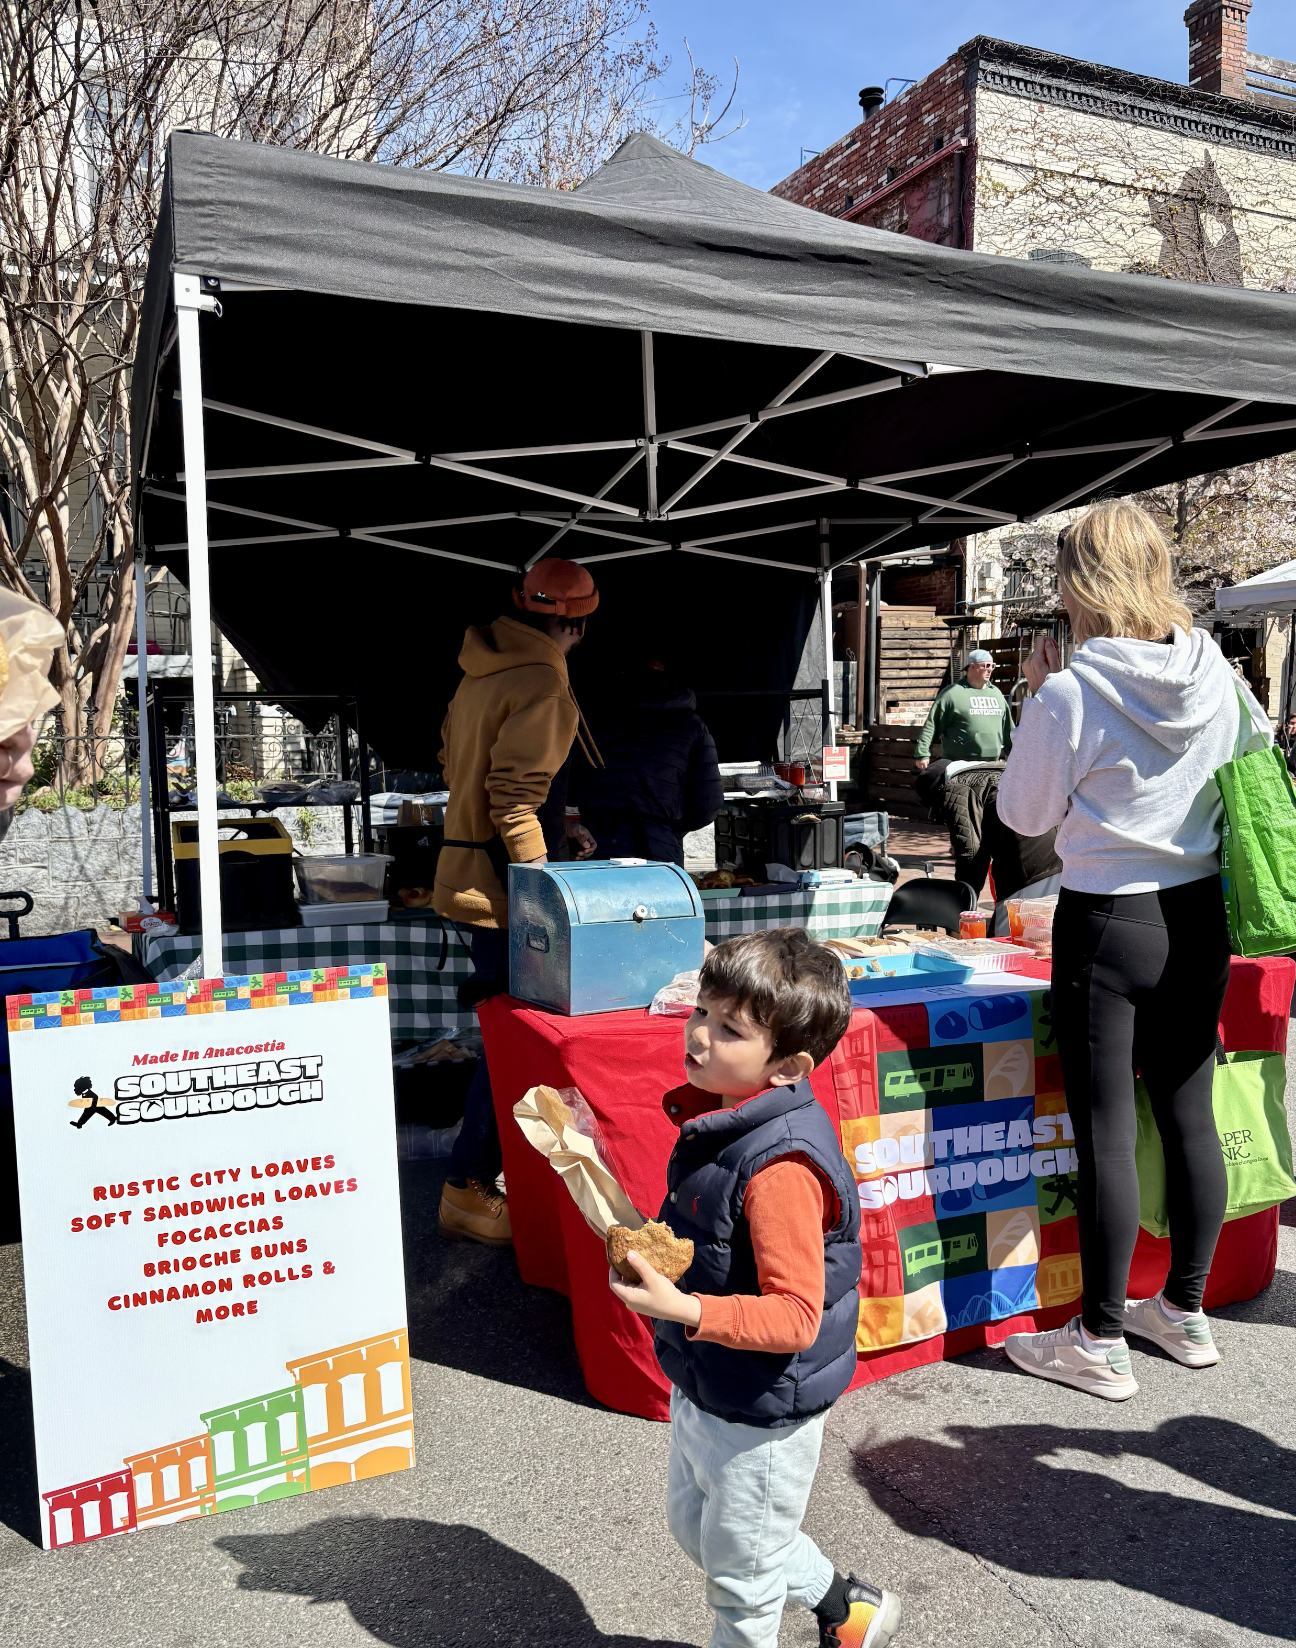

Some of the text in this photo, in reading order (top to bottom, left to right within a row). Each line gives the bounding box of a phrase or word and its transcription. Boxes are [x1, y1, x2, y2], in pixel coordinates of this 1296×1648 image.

[969, 696, 1000, 708] OHIO
[131, 1039, 286, 1067] Made In Anacostia
[114, 1055, 323, 1101] SOUTHEAST
[116, 1079, 324, 1125] SOURDOUGH
[854, 1112, 1075, 1174] SOUTHEAST
[1220, 1129, 1254, 1146] PER
[1221, 1146, 1251, 1160] NK
[92, 1154, 335, 1202] RUSTIC CITY LOAVES
[857, 1147, 1080, 1209] SOURDOUGH
[70, 1177, 358, 1233] SOFT SANDWICH LOAVES
[157, 1215, 284, 1248] FOCACCIAS
[143, 1238, 308, 1278] BRIOCHE BUNS
[107, 1260, 336, 1311] CINNAMON ROLLS &
[195, 1299, 258, 1324] MORE
